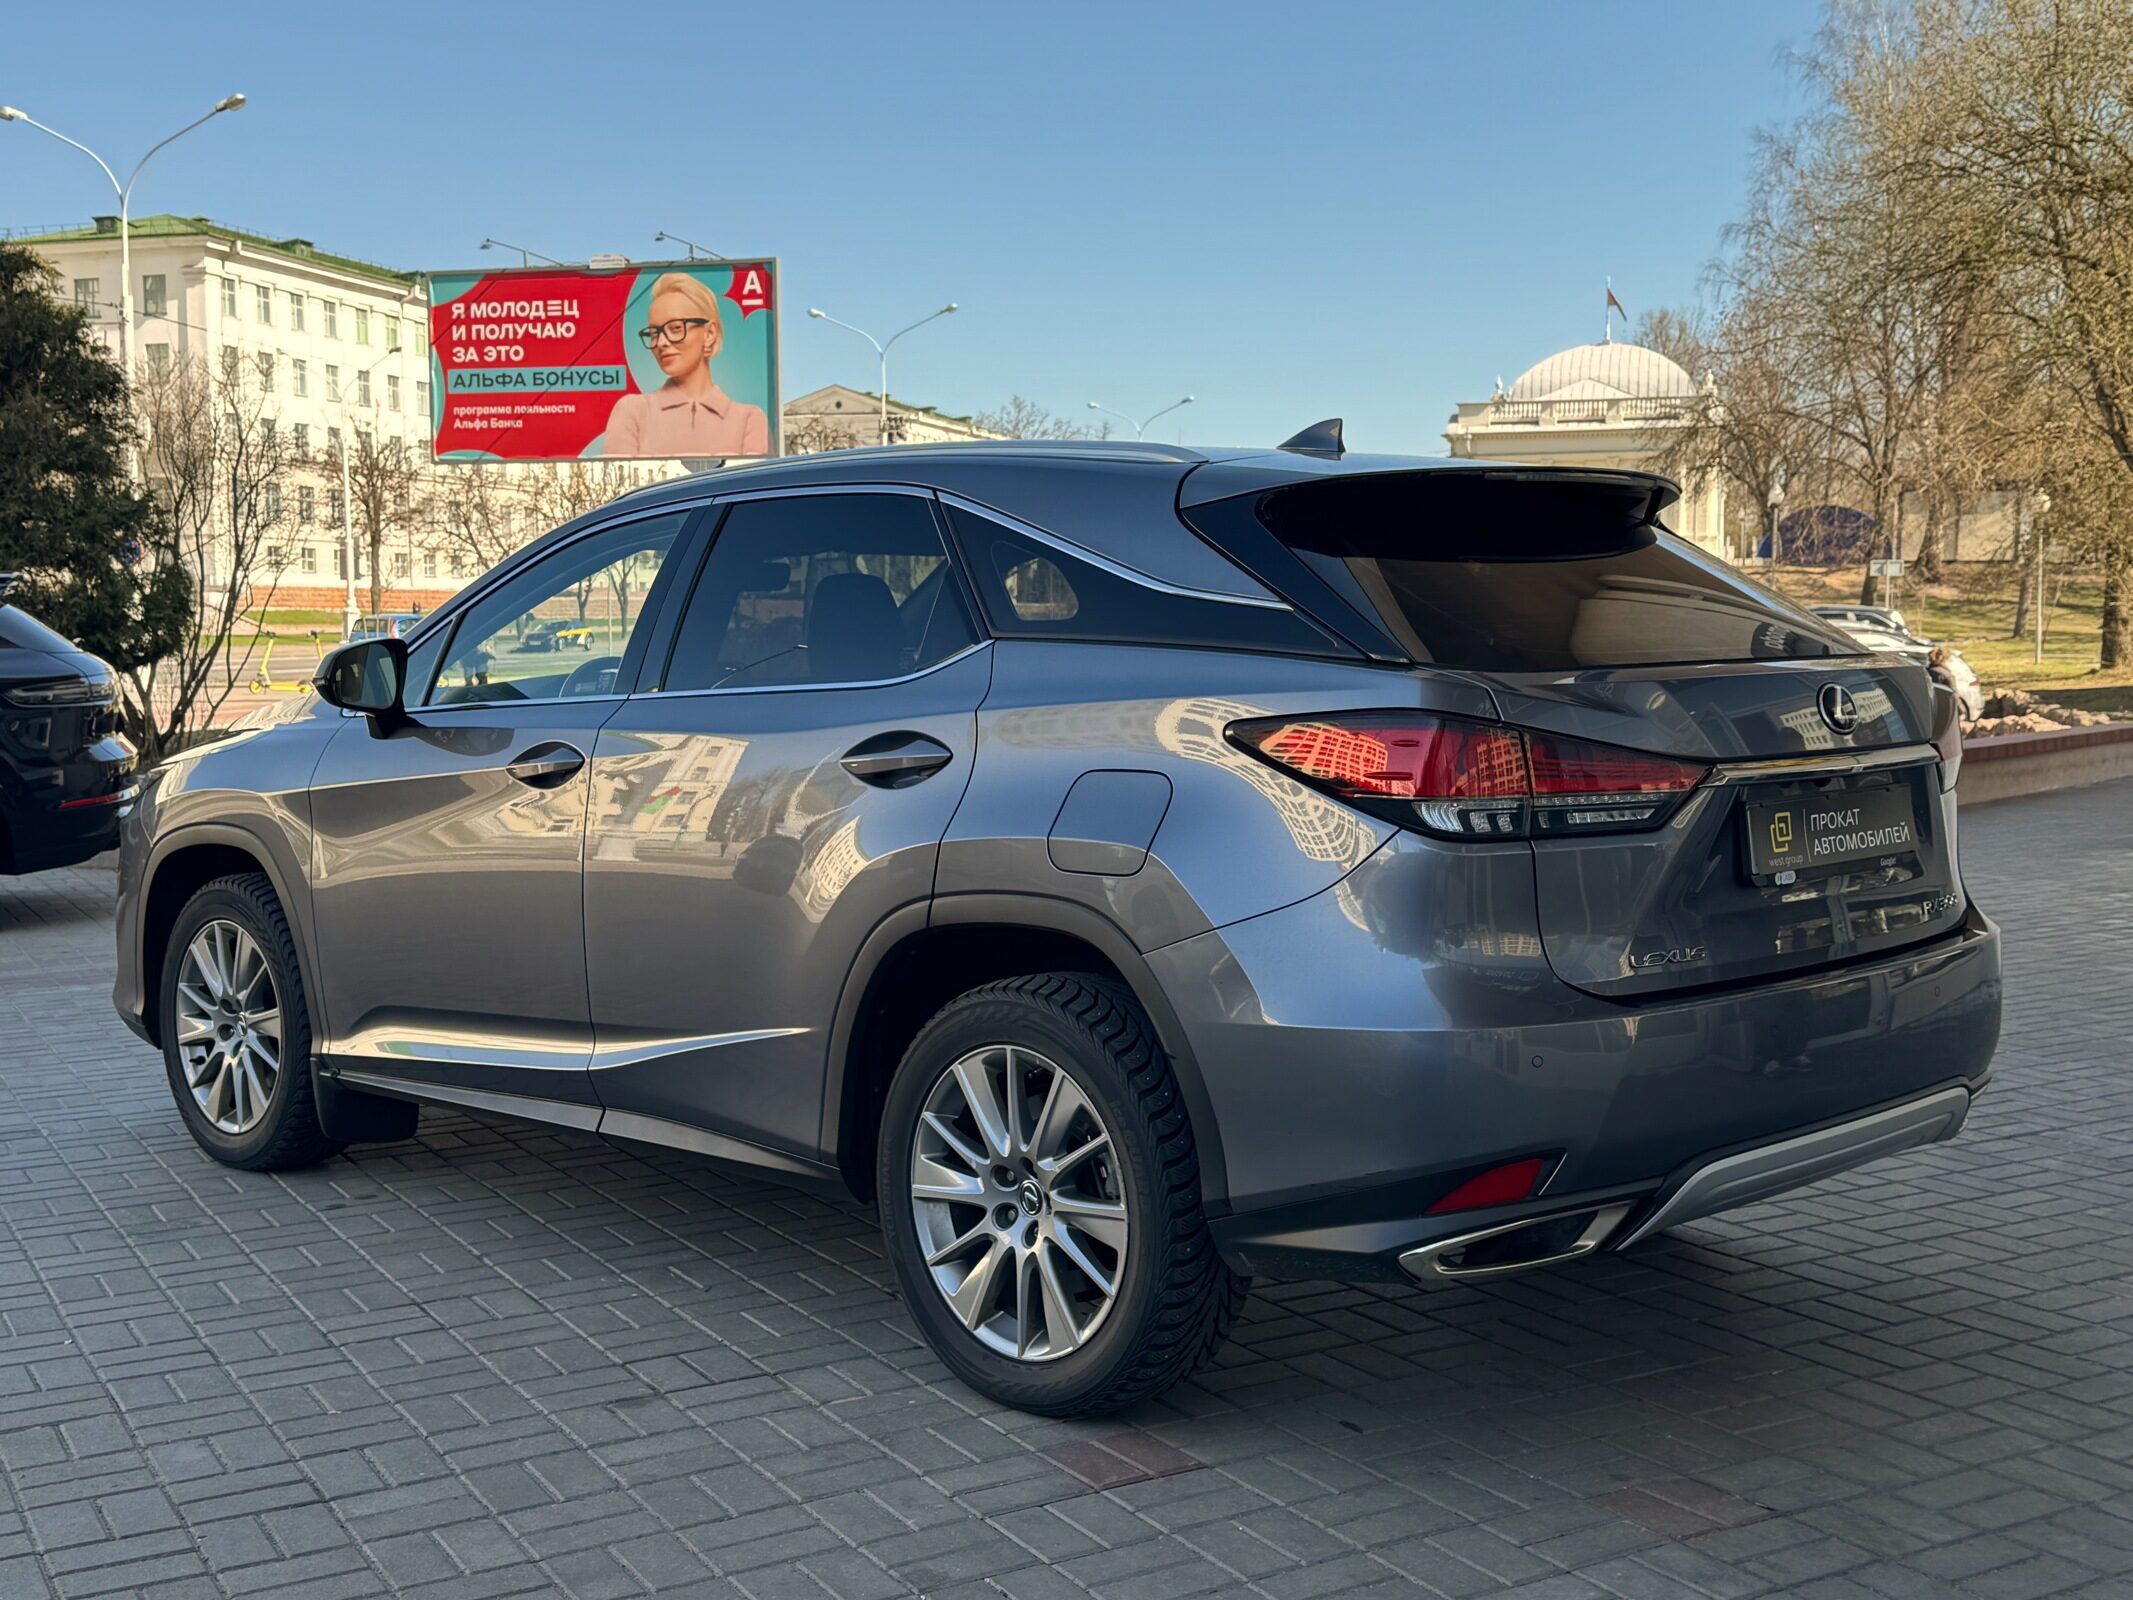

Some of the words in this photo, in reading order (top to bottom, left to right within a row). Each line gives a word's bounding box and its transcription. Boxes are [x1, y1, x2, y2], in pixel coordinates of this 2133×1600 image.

[451, 303, 465, 319] Я
[470, 299, 580, 320] МОЛОДЕЦ
[451, 325, 466, 341] И
[471, 321, 576, 341] ПОЛУЧАЮ
[452, 345, 479, 363] ЗА
[483, 345, 525, 362] ЭТО
[453, 372, 527, 388] АЛЬФА
[533, 370, 620, 386] БОНУСЫ
[453, 405, 512, 417] программа
[514, 404, 575, 414] лояльности
[453, 418, 488, 431] Альфа
[490, 417, 523, 428] Банка
[1810, 808, 1861, 832] ПРОКАТ
[1813, 821, 1911, 856] АВТОМОБИЛЕЙ
[1629, 946, 1706, 968] LEXUS
